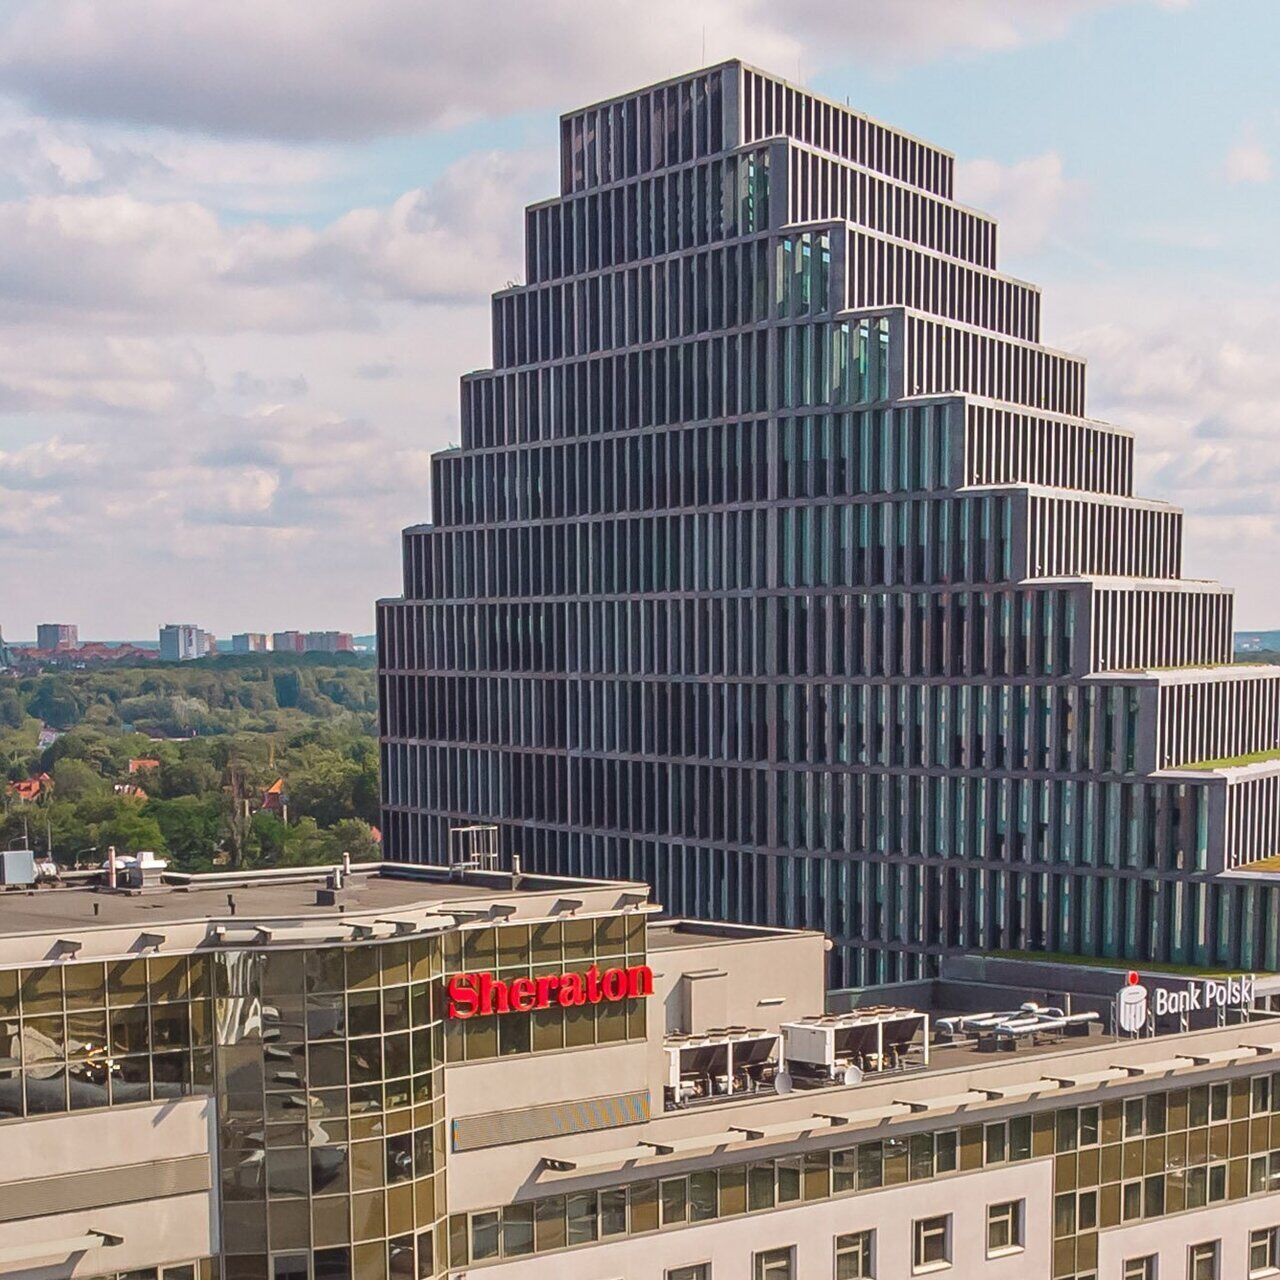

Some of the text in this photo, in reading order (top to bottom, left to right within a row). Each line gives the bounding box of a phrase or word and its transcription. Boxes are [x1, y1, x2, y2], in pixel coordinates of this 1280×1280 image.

[448, 964, 655, 1019] Sheraton
[1154, 974, 1256, 1015] Bank Polski
